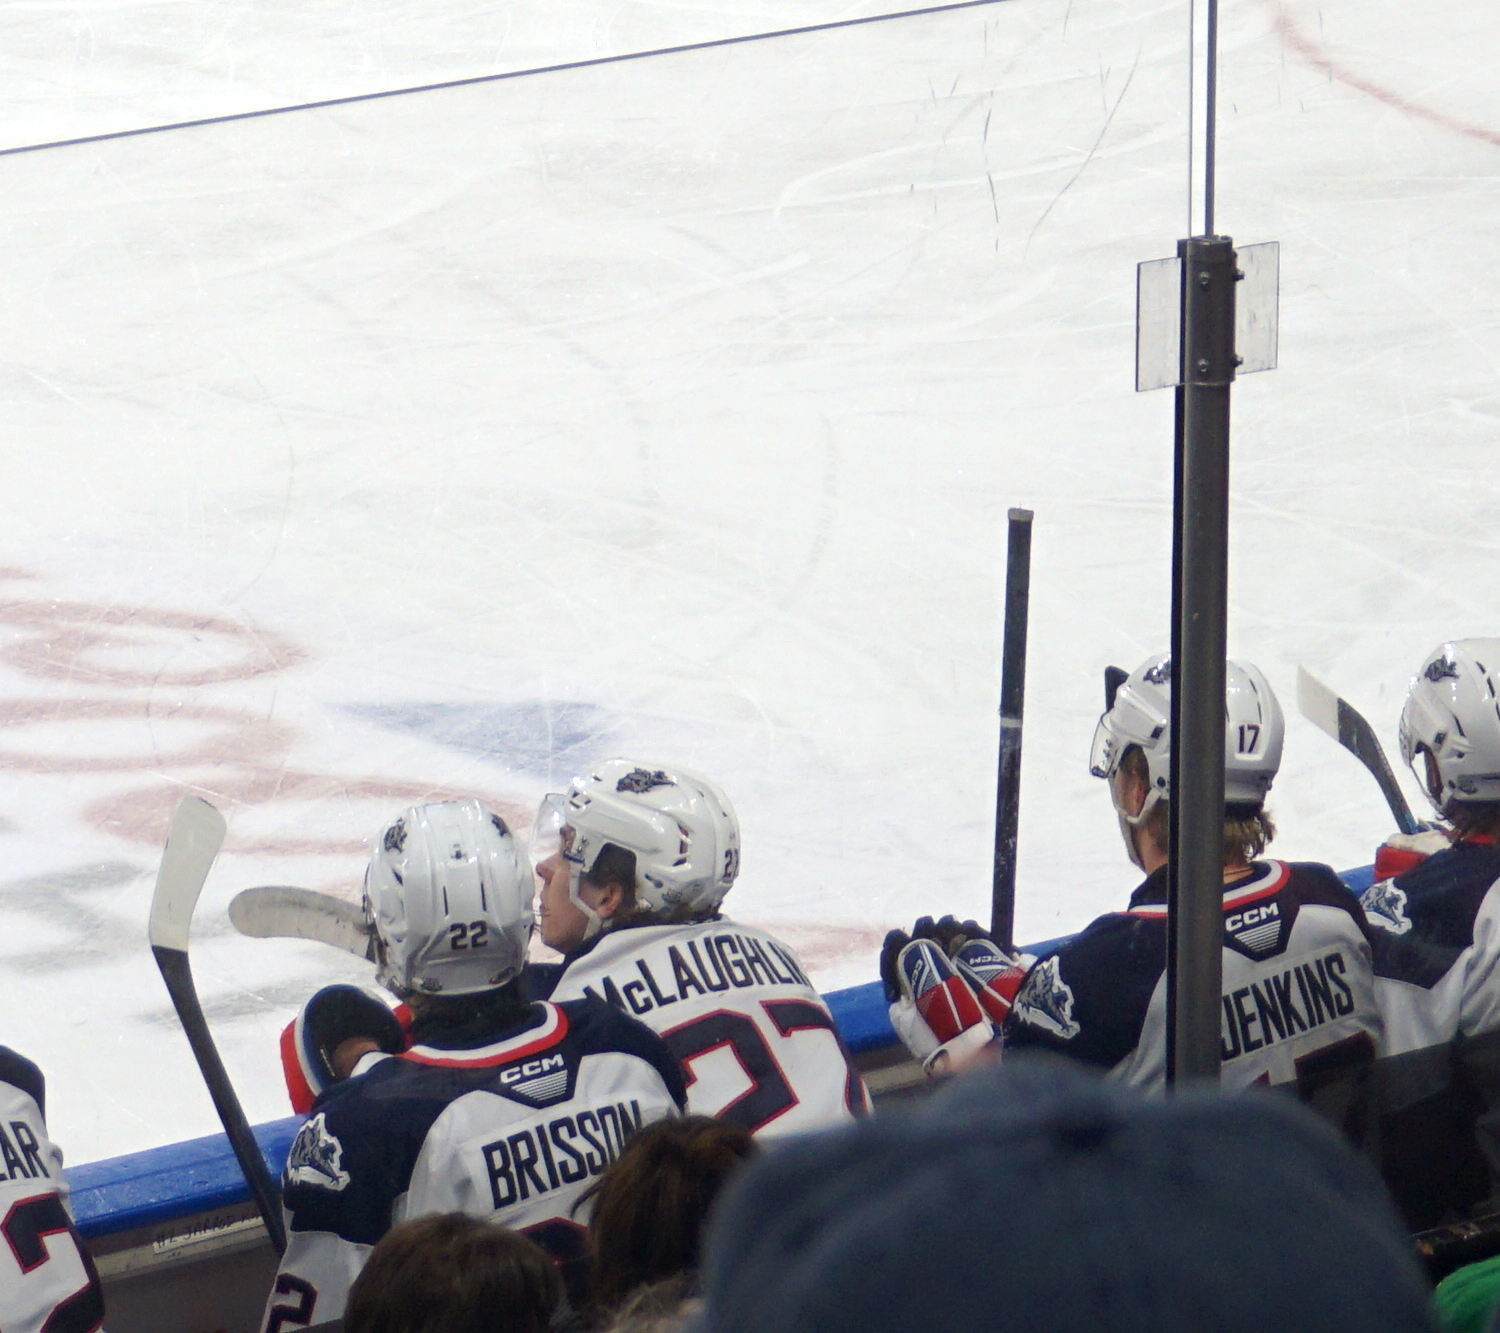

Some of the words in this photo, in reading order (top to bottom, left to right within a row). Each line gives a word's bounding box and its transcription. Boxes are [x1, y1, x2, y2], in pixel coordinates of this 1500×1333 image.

[1237, 724, 1260, 753] 17
[1225, 901, 1280, 932] CCM
[449, 920, 488, 949] 22
[499, 1054, 565, 1084] CCM
[482, 1099, 643, 1212] BRISSON
